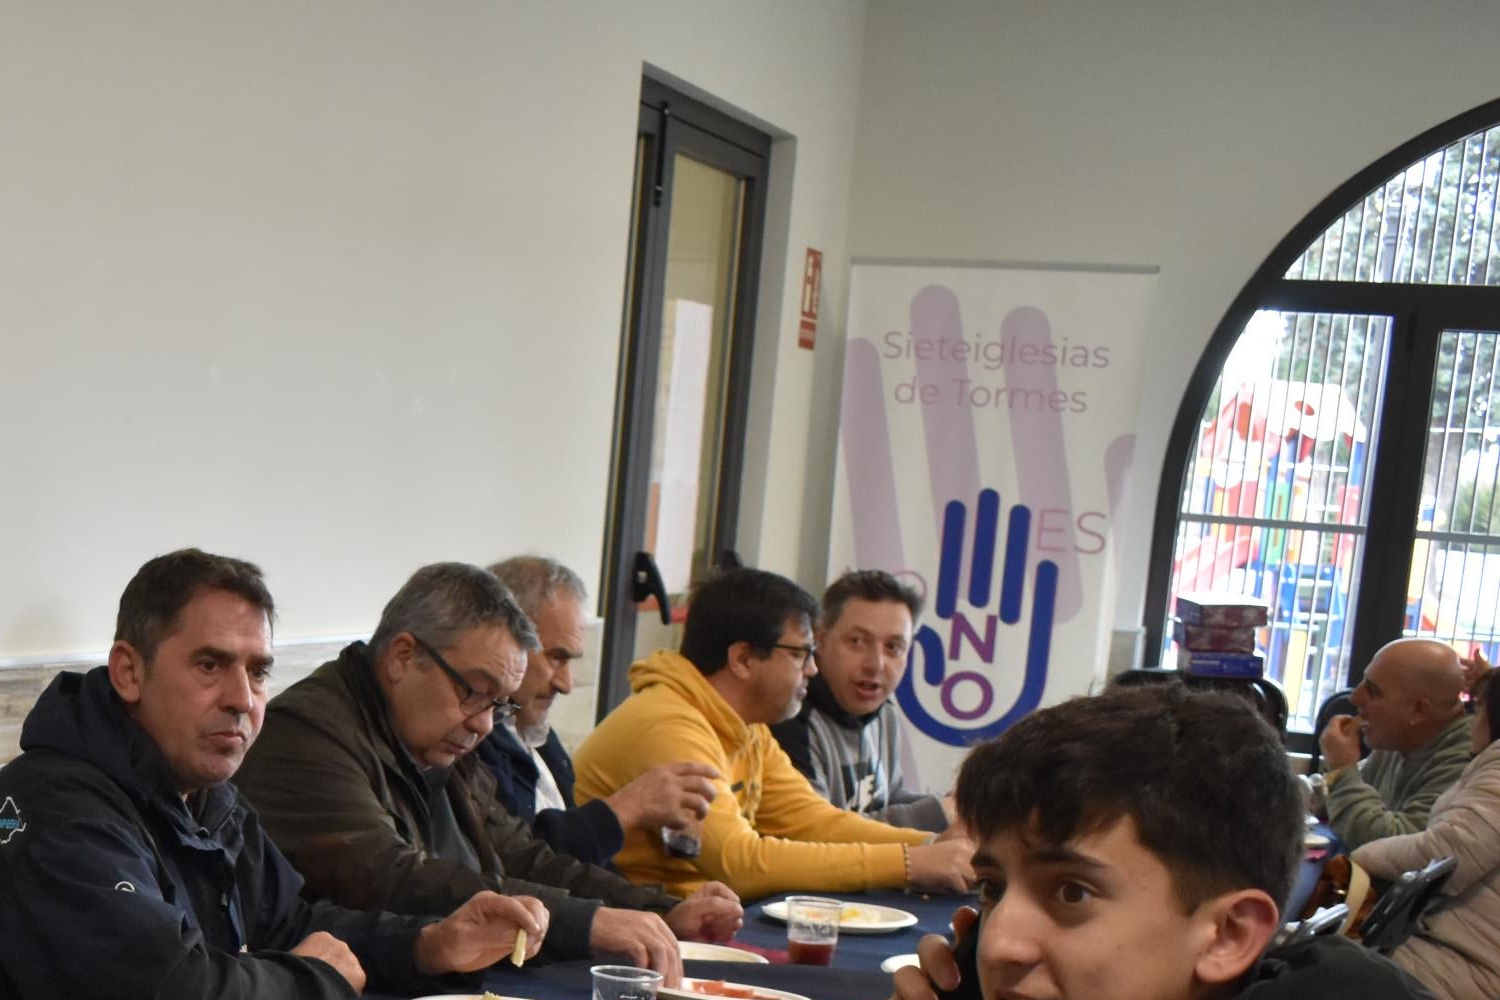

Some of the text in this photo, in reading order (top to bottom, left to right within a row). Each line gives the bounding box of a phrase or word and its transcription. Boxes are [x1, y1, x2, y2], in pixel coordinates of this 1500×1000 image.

[883, 331, 1110, 370] Sieteiglesias
[894, 376, 1088, 413] de Tormes
[1036, 508, 1107, 555] ES
